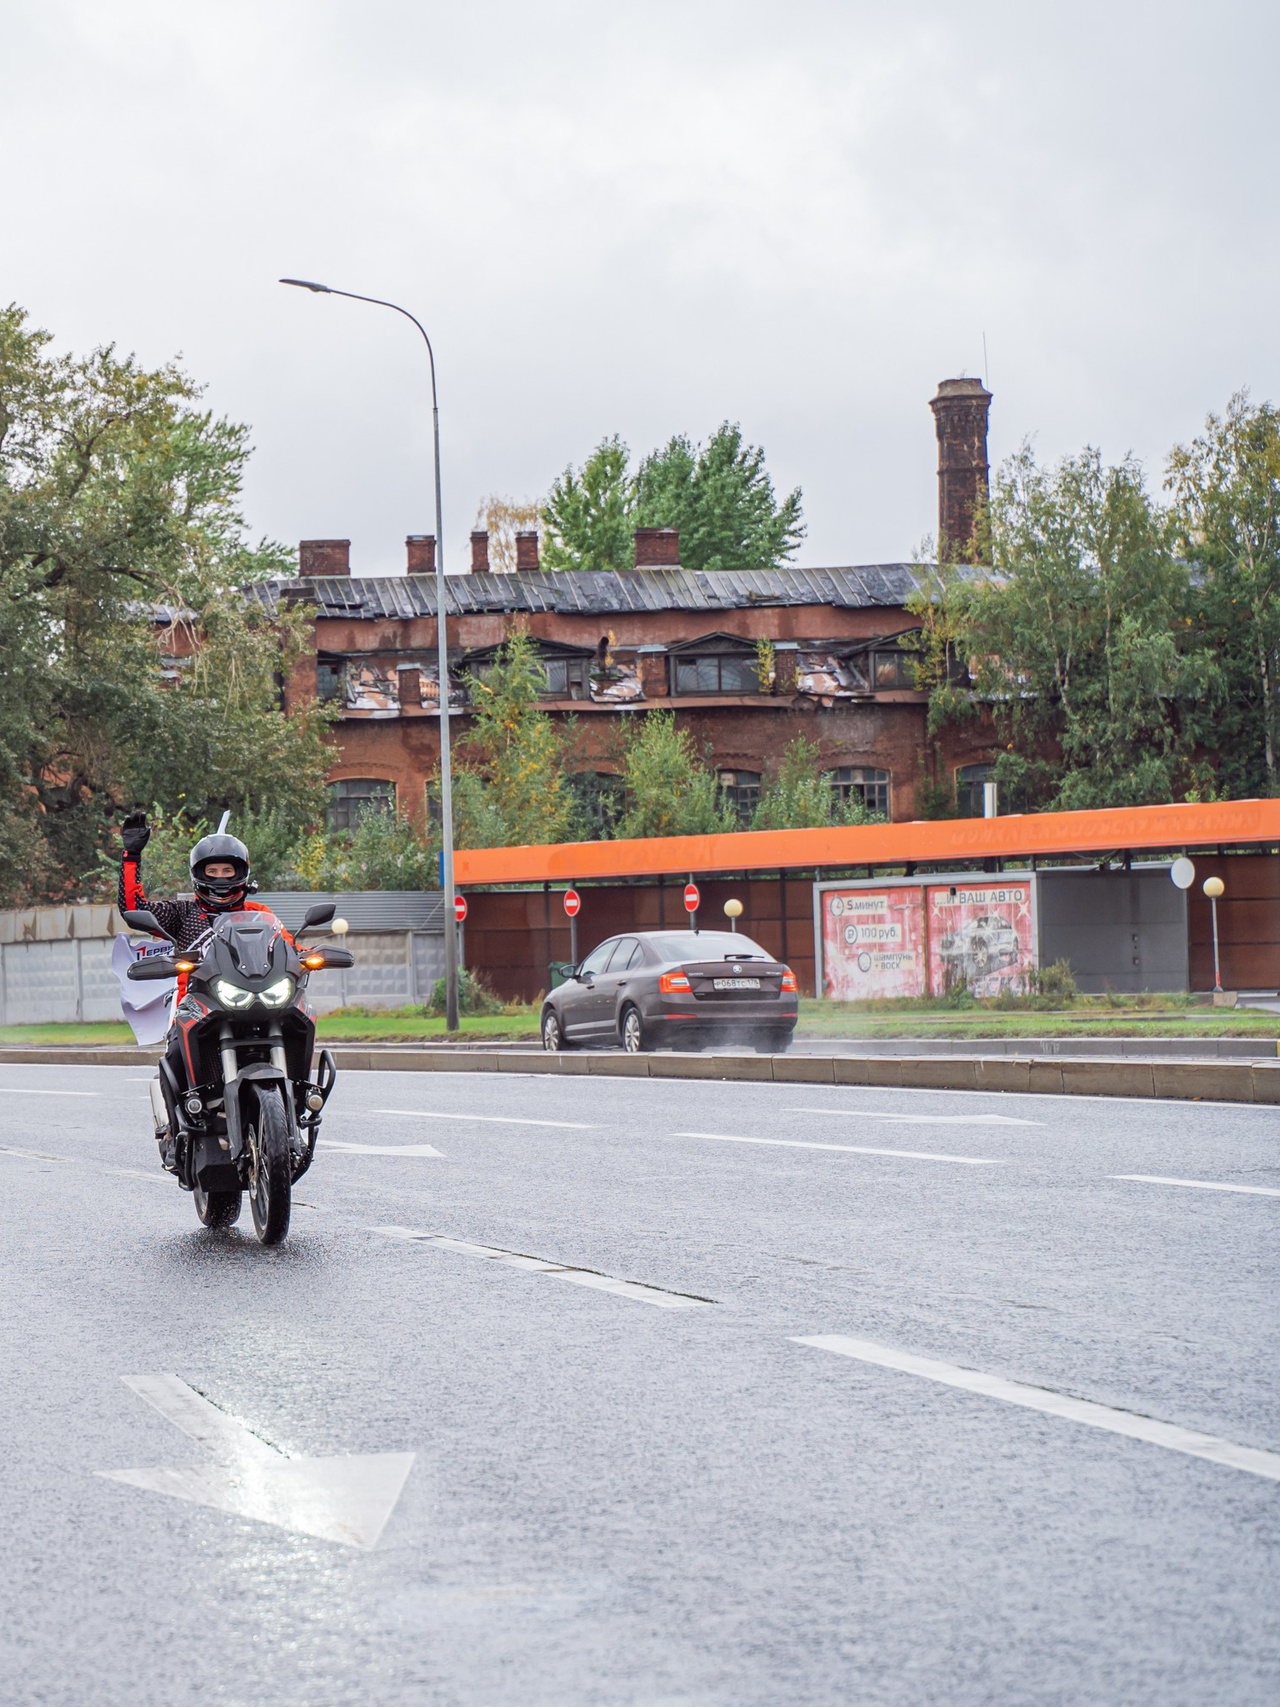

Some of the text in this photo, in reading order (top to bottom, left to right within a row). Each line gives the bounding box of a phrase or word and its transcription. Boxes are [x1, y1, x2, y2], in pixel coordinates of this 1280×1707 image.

[960, 892, 985, 904] ВАШ
[990, 890, 1022, 902] АВТО
[847, 900, 884, 910] 5 минут
[861, 928, 898, 939] 100 руб.
[874, 953, 913, 963] шампунь
[881, 961, 901, 969] воск
